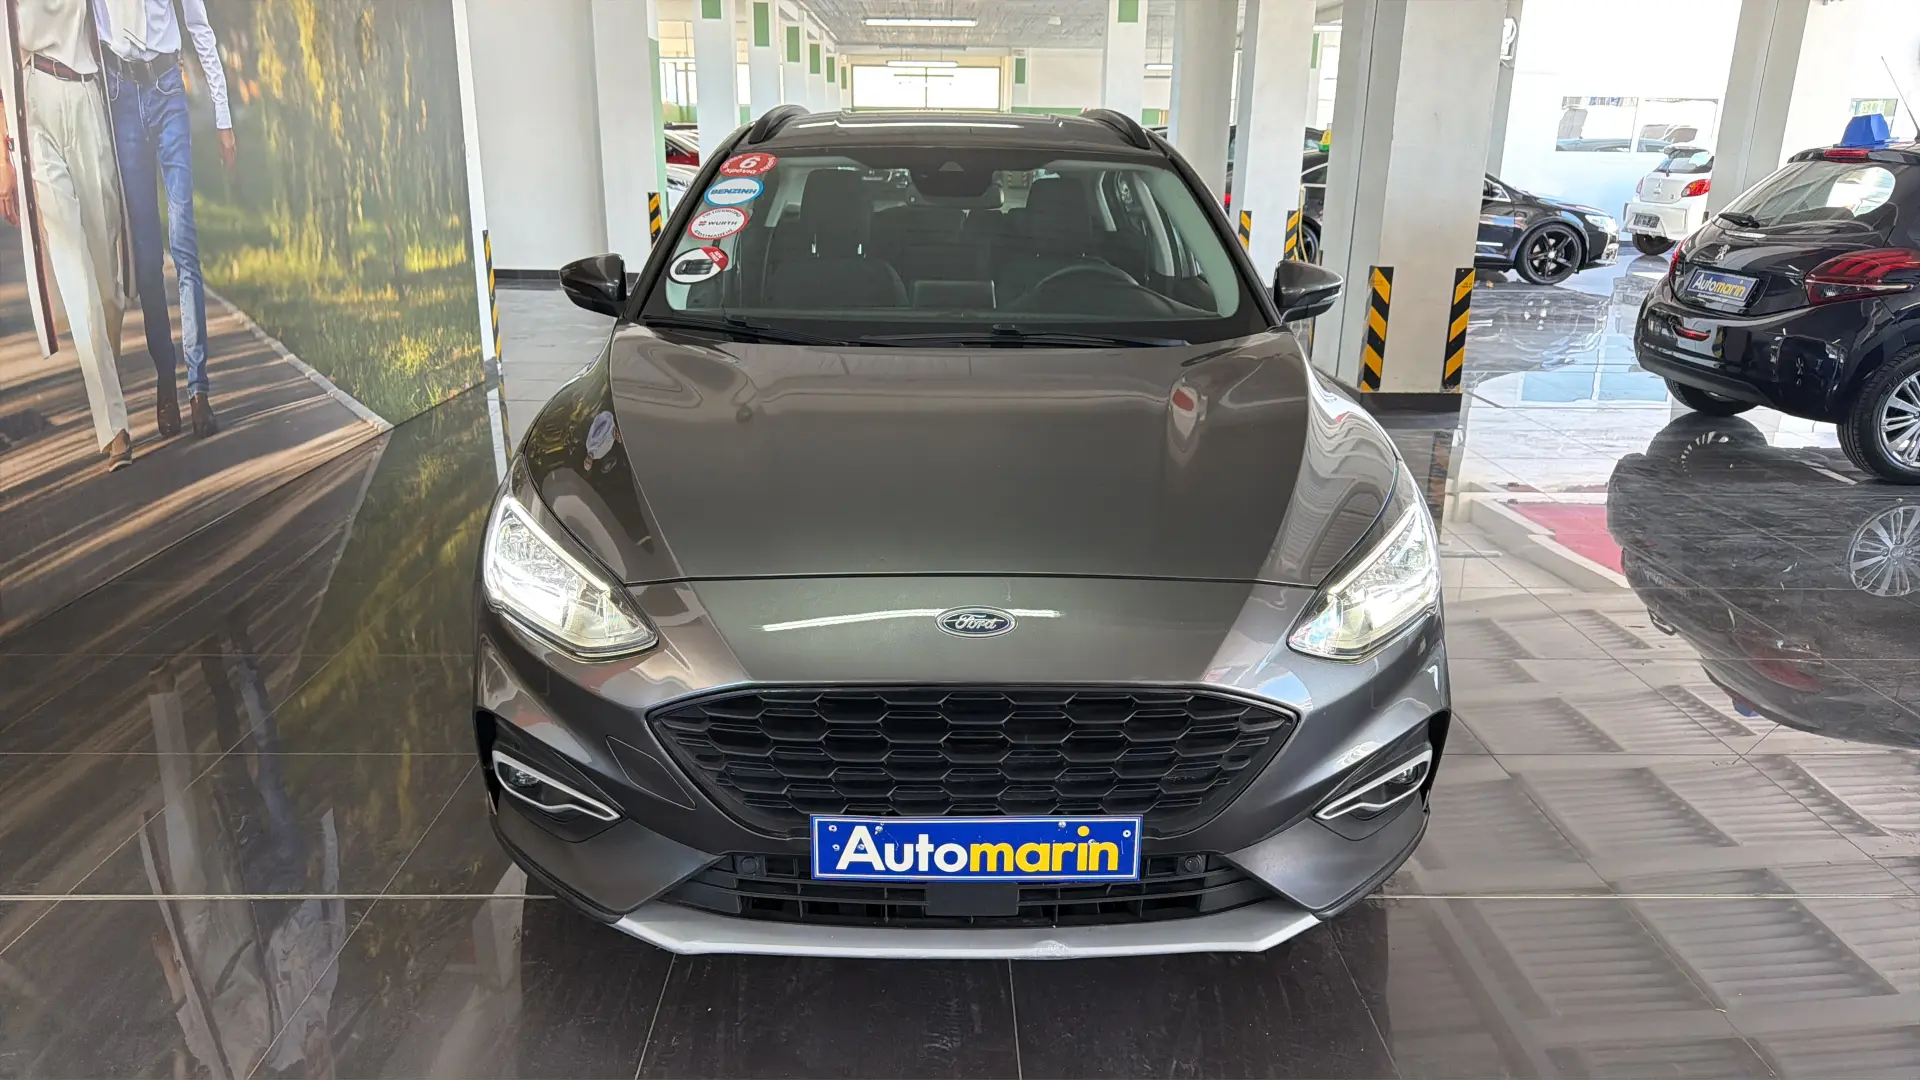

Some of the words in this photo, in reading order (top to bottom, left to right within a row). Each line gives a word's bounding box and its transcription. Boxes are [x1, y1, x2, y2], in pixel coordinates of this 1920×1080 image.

[739, 155, 761, 169] 6
[1692, 272, 1746, 297] Automarin
[954, 613, 997, 629] Ford
[835, 825, 1119, 872] Automarin
